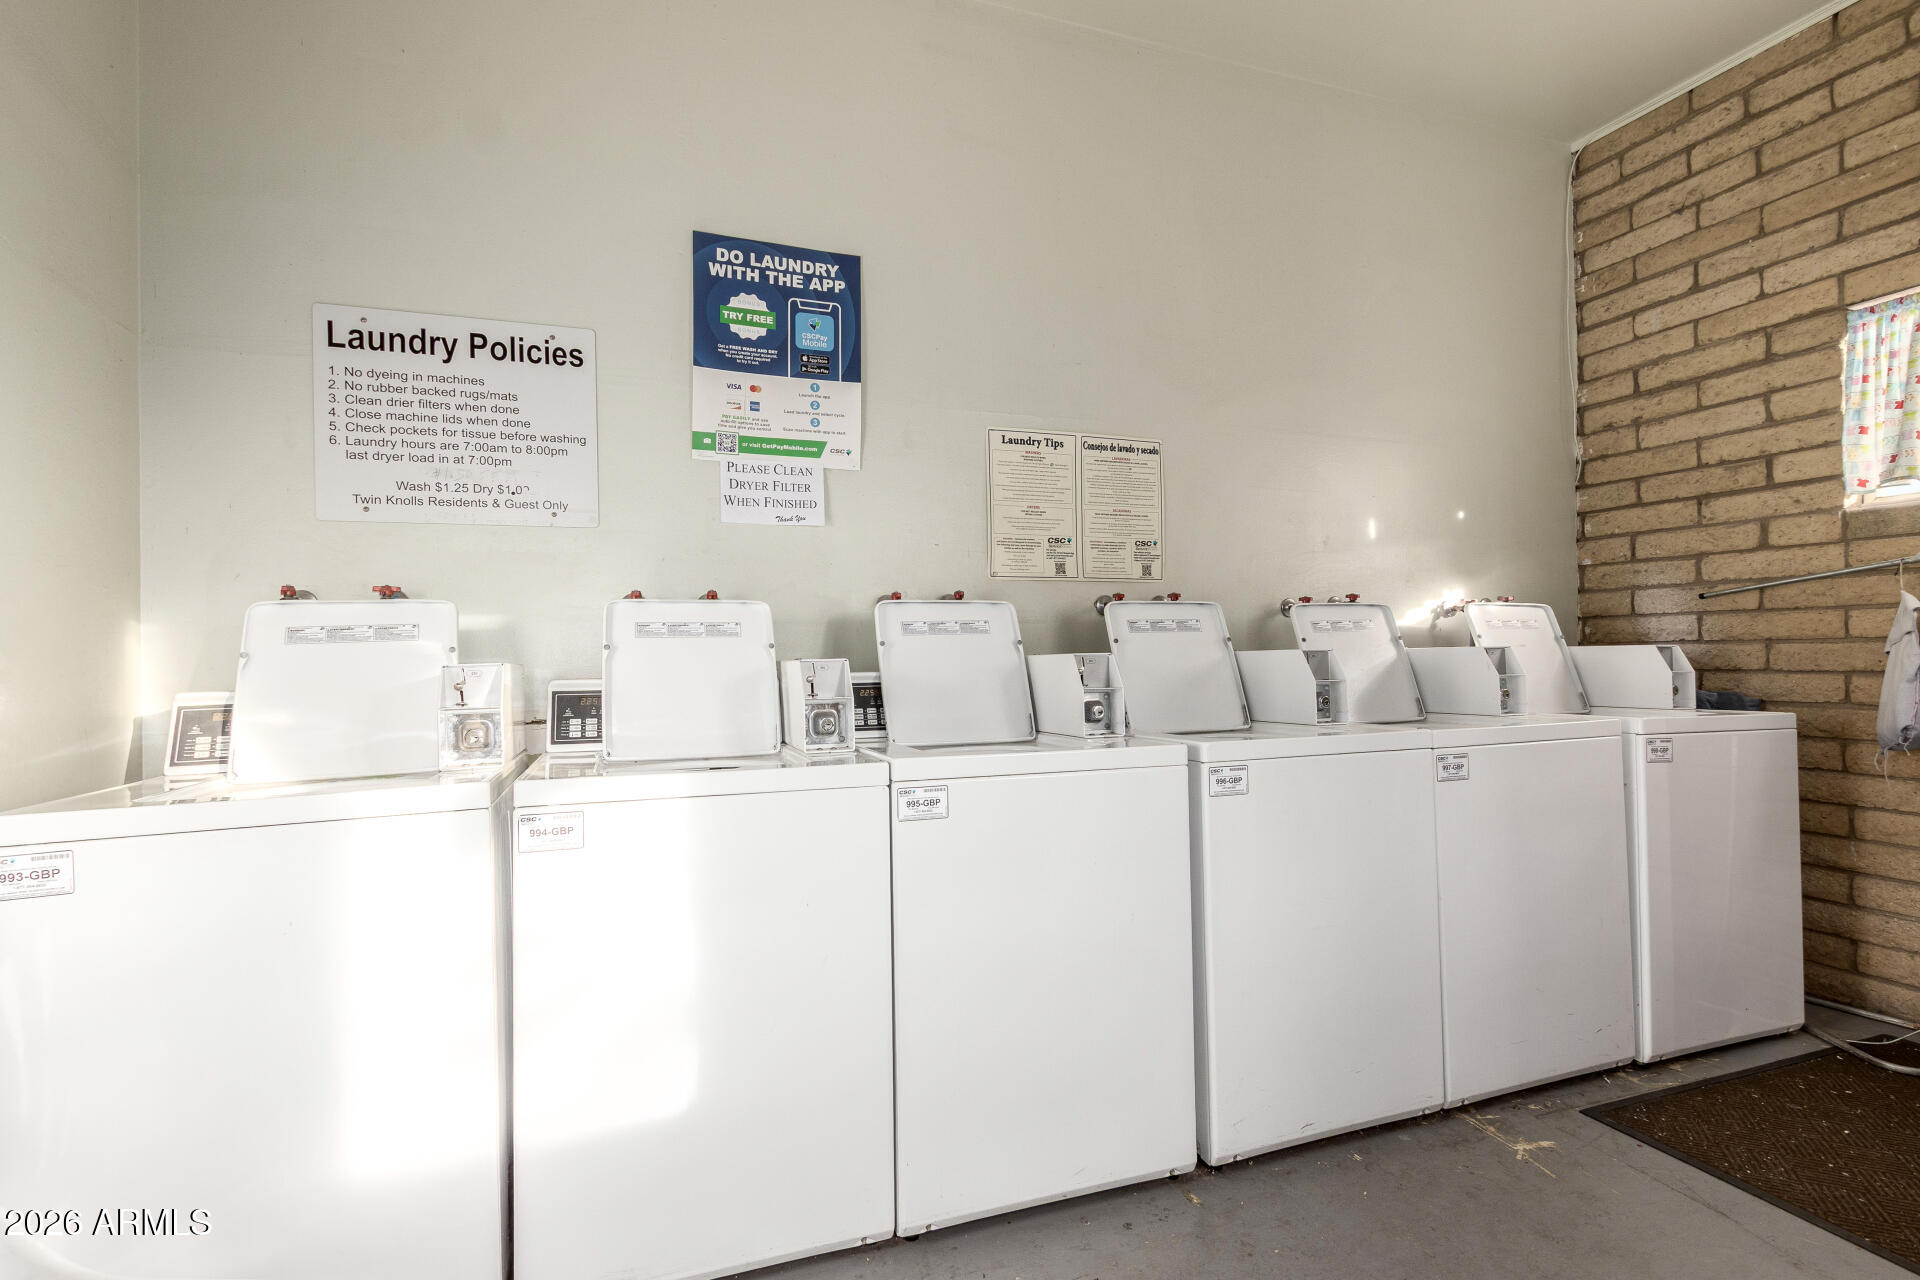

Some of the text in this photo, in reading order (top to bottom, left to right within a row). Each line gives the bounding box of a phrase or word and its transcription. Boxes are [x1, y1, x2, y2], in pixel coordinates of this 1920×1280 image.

[716, 248, 840, 278] DO LAUNDRY
[708, 262, 845, 293] WITH THE APP
[722, 310, 773, 325] TRY FREE
[327, 320, 584, 368] Laundry Policies
[802, 339, 827, 348] Mobile
[328, 366, 484, 386] 1. No dyeing in machines
[328, 380, 518, 401] 2. No rubber backed rugs/mats
[328, 393, 520, 414] 3. Clean drier filters when done
[328, 407, 530, 428] 4. Close machine lids when done
[329, 421, 586, 446] 5. Check pockets for tissue before washing
[329, 435, 340, 445] 6.
[346, 435, 397, 449] Laundry
[402, 438, 436, 449] hours
[463, 442, 507, 453] 7:00am
[512, 445, 522, 454] to
[526, 445, 568, 457] 8:00pm
[762, 443, 818, 453] GetPayMobile.com
[1002, 435, 1064, 450] Laundry Tips
[1083, 441, 1109, 452] Consejos
[1110, 443, 1116, 451] de
[1117, 444, 1135, 454] lavado
[1140, 447, 1159, 456] secado
[346, 450, 512, 467] last dryer load in at 7:00pm
[727, 462, 813, 476] PLEASE CLEAN
[396, 481, 430, 491] Wash
[435, 482, 468, 493] $1.25
[473, 484, 494, 496] Dry
[729, 478, 812, 493] DRYER FILTER
[352, 494, 568, 512] Twin Knolls Residents & Guest Only
[723, 495, 817, 509] WHEN FINISHED
[776, 515, 806, 523] Thank You
[1215, 777, 1243, 785] 996-GBP
[906, 799, 941, 808] 995-GBP
[529, 827, 574, 837] 994-GBP
[0, 868, 60, 883] 993-GBP
